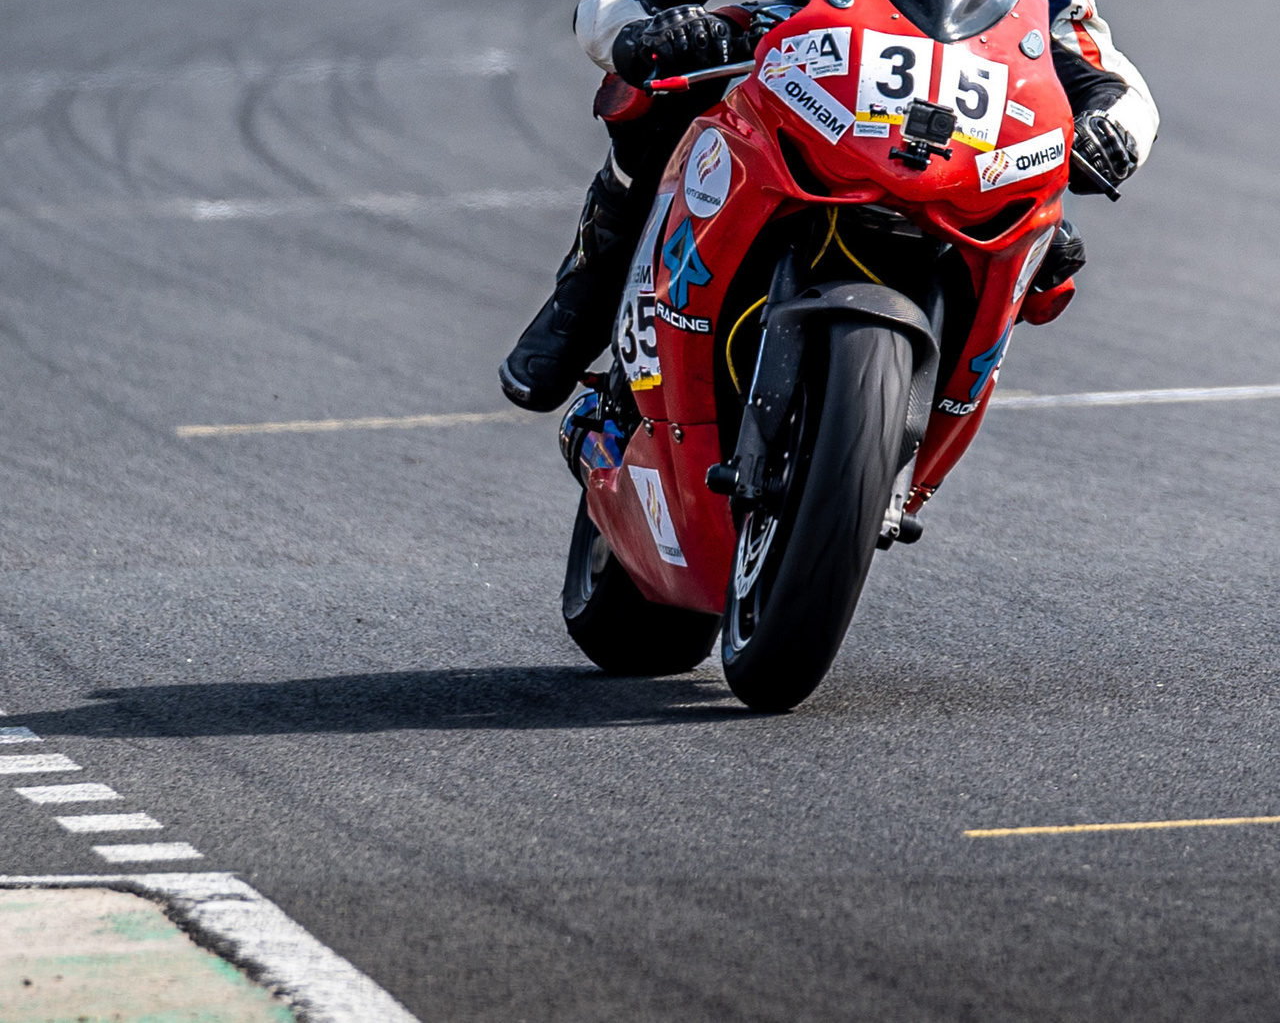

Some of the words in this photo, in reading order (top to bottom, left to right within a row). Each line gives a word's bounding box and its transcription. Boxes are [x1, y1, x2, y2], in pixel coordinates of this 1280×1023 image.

[876, 46, 916, 99] 3
[970, 127, 989, 141] eni
[621, 296, 658, 364] 35
[657, 303, 709, 331] RACING
